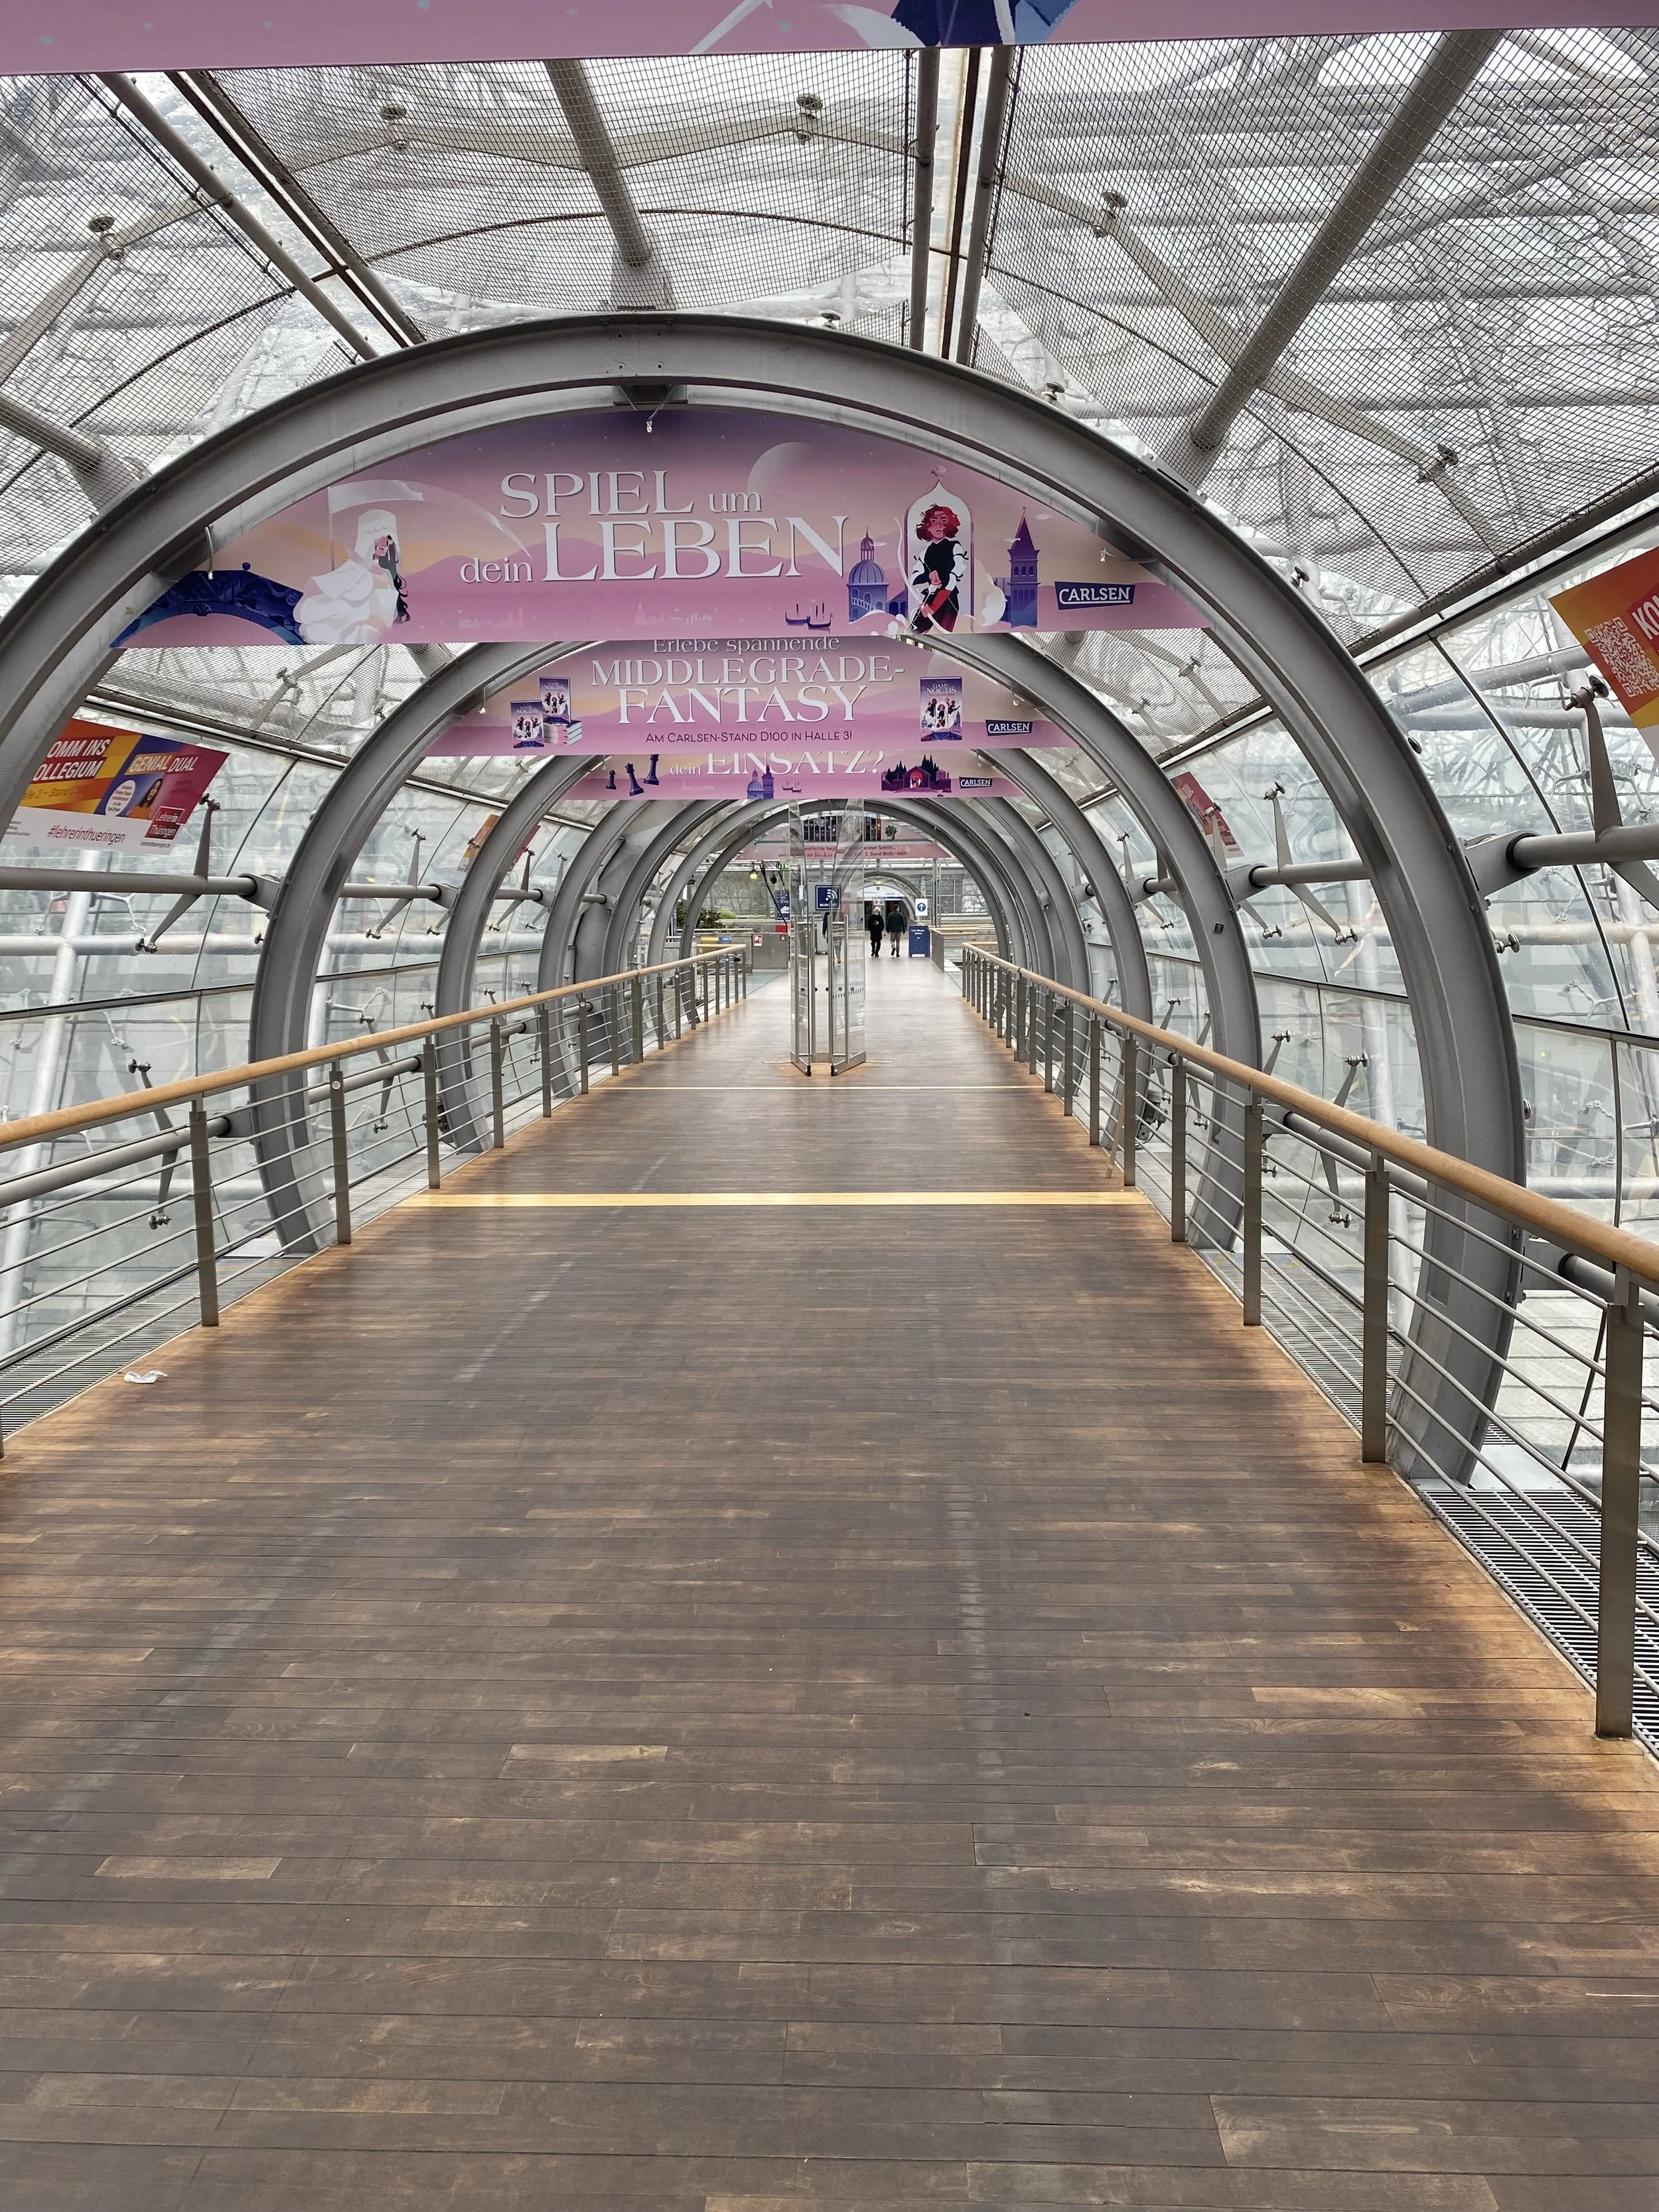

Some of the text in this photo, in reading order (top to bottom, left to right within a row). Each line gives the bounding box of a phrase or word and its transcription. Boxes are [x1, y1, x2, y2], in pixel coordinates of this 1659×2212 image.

[500, 470, 762, 518] SPIEL um
[460, 516, 849, 583] dein LEBEN
[1059, 587, 1130, 605] CARLSEN
[654, 636, 840, 656] Erlebe spannende
[591, 656, 904, 686] MIDDLEGRADE-
[617, 686, 867, 724] FANTASY
[645, 733, 664, 743] AM
[760, 731, 789, 741] D100
[791, 732, 802, 741] IN
[804, 731, 840, 741] HALLE
[843, 731, 853, 740] 3!
[988, 723, 1030, 733] CARLSEN
[46, 739, 111, 758] OMM INS
[33, 761, 104, 782] OLLEGIUM
[128, 755, 198, 773] GENIAL DUAL
[670, 751, 885, 776] dein EINSATZ?
[47, 824, 125, 845] #lehrerinthueringen
[149, 824, 177, 838] Thüringen
